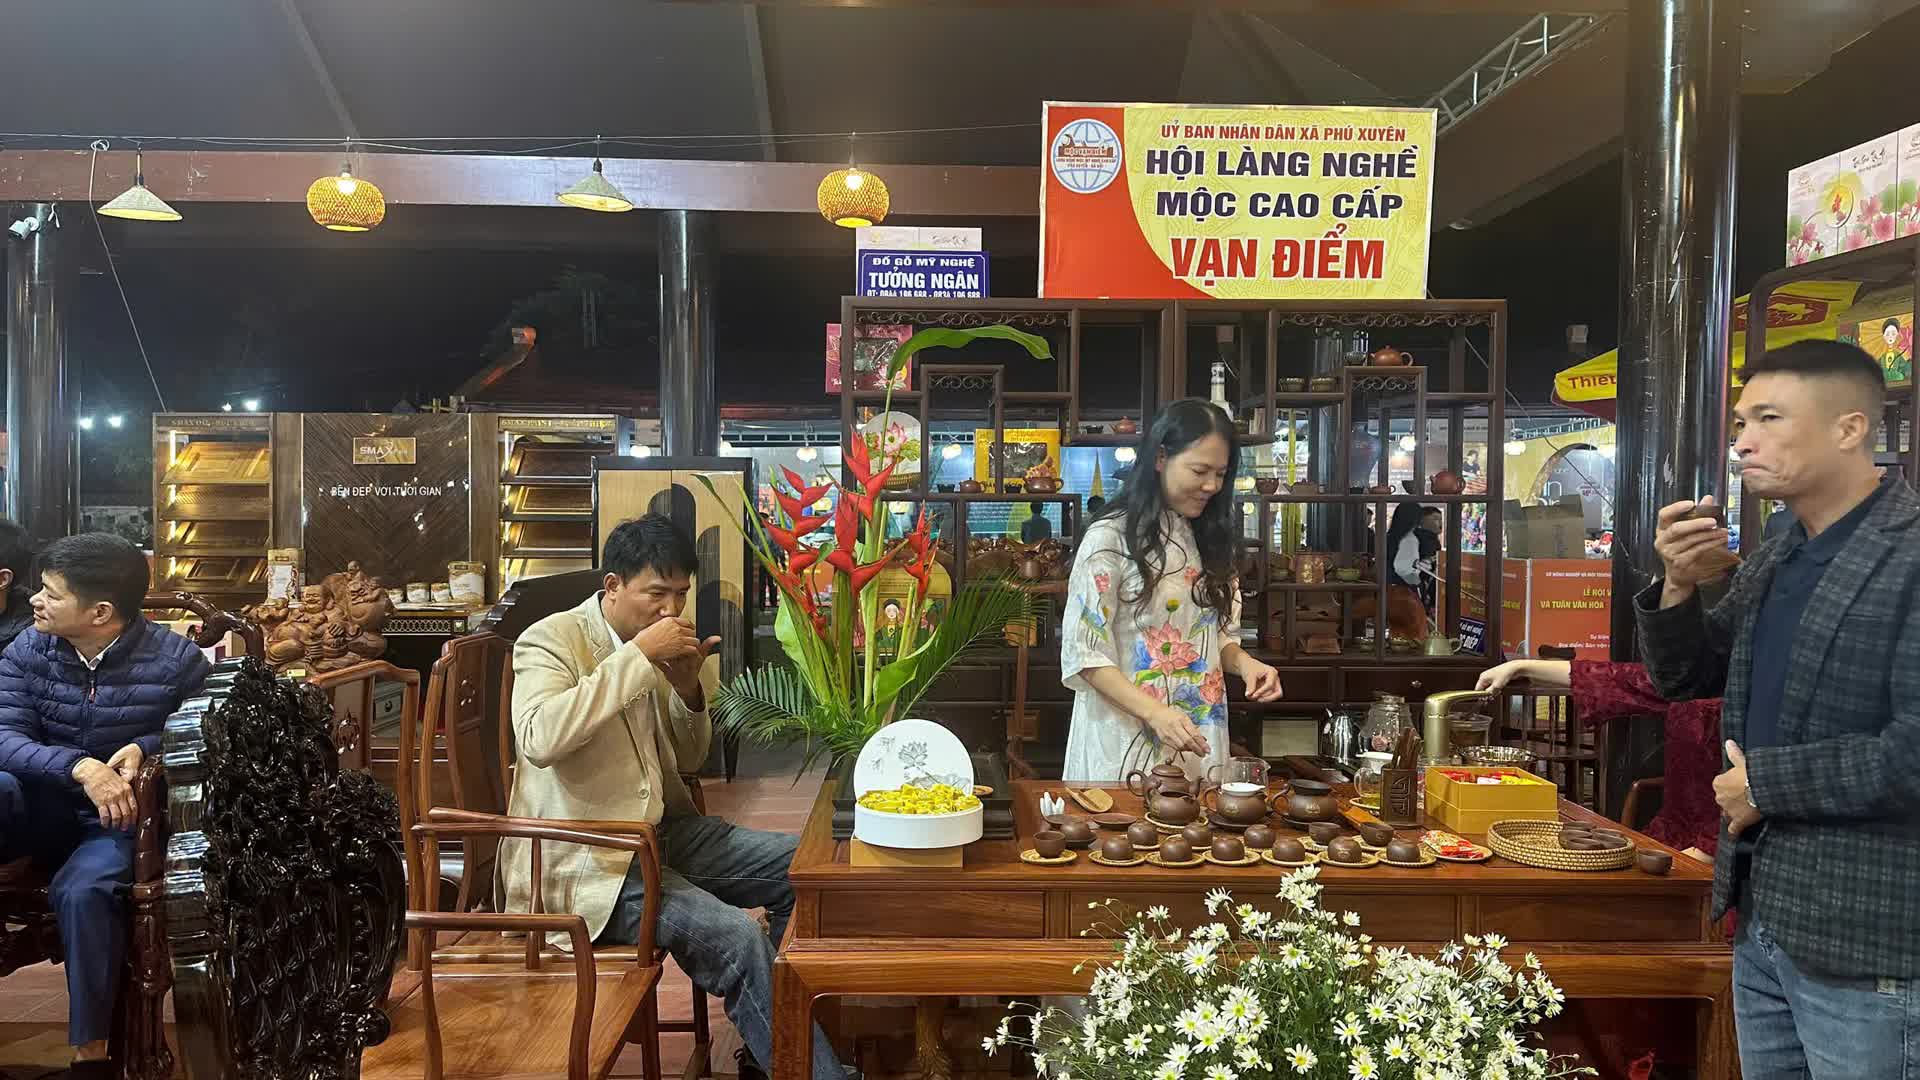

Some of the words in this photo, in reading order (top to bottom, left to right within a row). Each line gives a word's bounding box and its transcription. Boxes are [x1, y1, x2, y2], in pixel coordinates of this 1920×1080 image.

[1184, 125, 1215, 139] BAN
[1219, 123, 1260, 139] NHÂN
[1265, 123, 1295, 140] DÂN
[1300, 124, 1319, 140] XÃ
[1324, 125, 1353, 140] PHÚ
[1358, 126, 1406, 142] XUYÊN
[1147, 145, 1204, 180] HỘI
[1217, 145, 1309, 177] LÀNG
[1322, 144, 1418, 178] NGHỀ
[1157, 186, 1236, 222] MỘC
[1249, 192, 1320, 218] CAO
[1332, 185, 1403, 219] CẤP
[894, 255, 912, 266] GỖ
[916, 257, 936, 267] MỸ
[940, 257, 975, 268] NGHỆ
[1170, 238, 1258, 286] VẠN
[1272, 222, 1385, 279] ĐIỂM
[868, 267, 926, 289] TƯỞNG
[930, 270, 979, 289] NGÂN
[420, 486, 442, 497] GIAN
